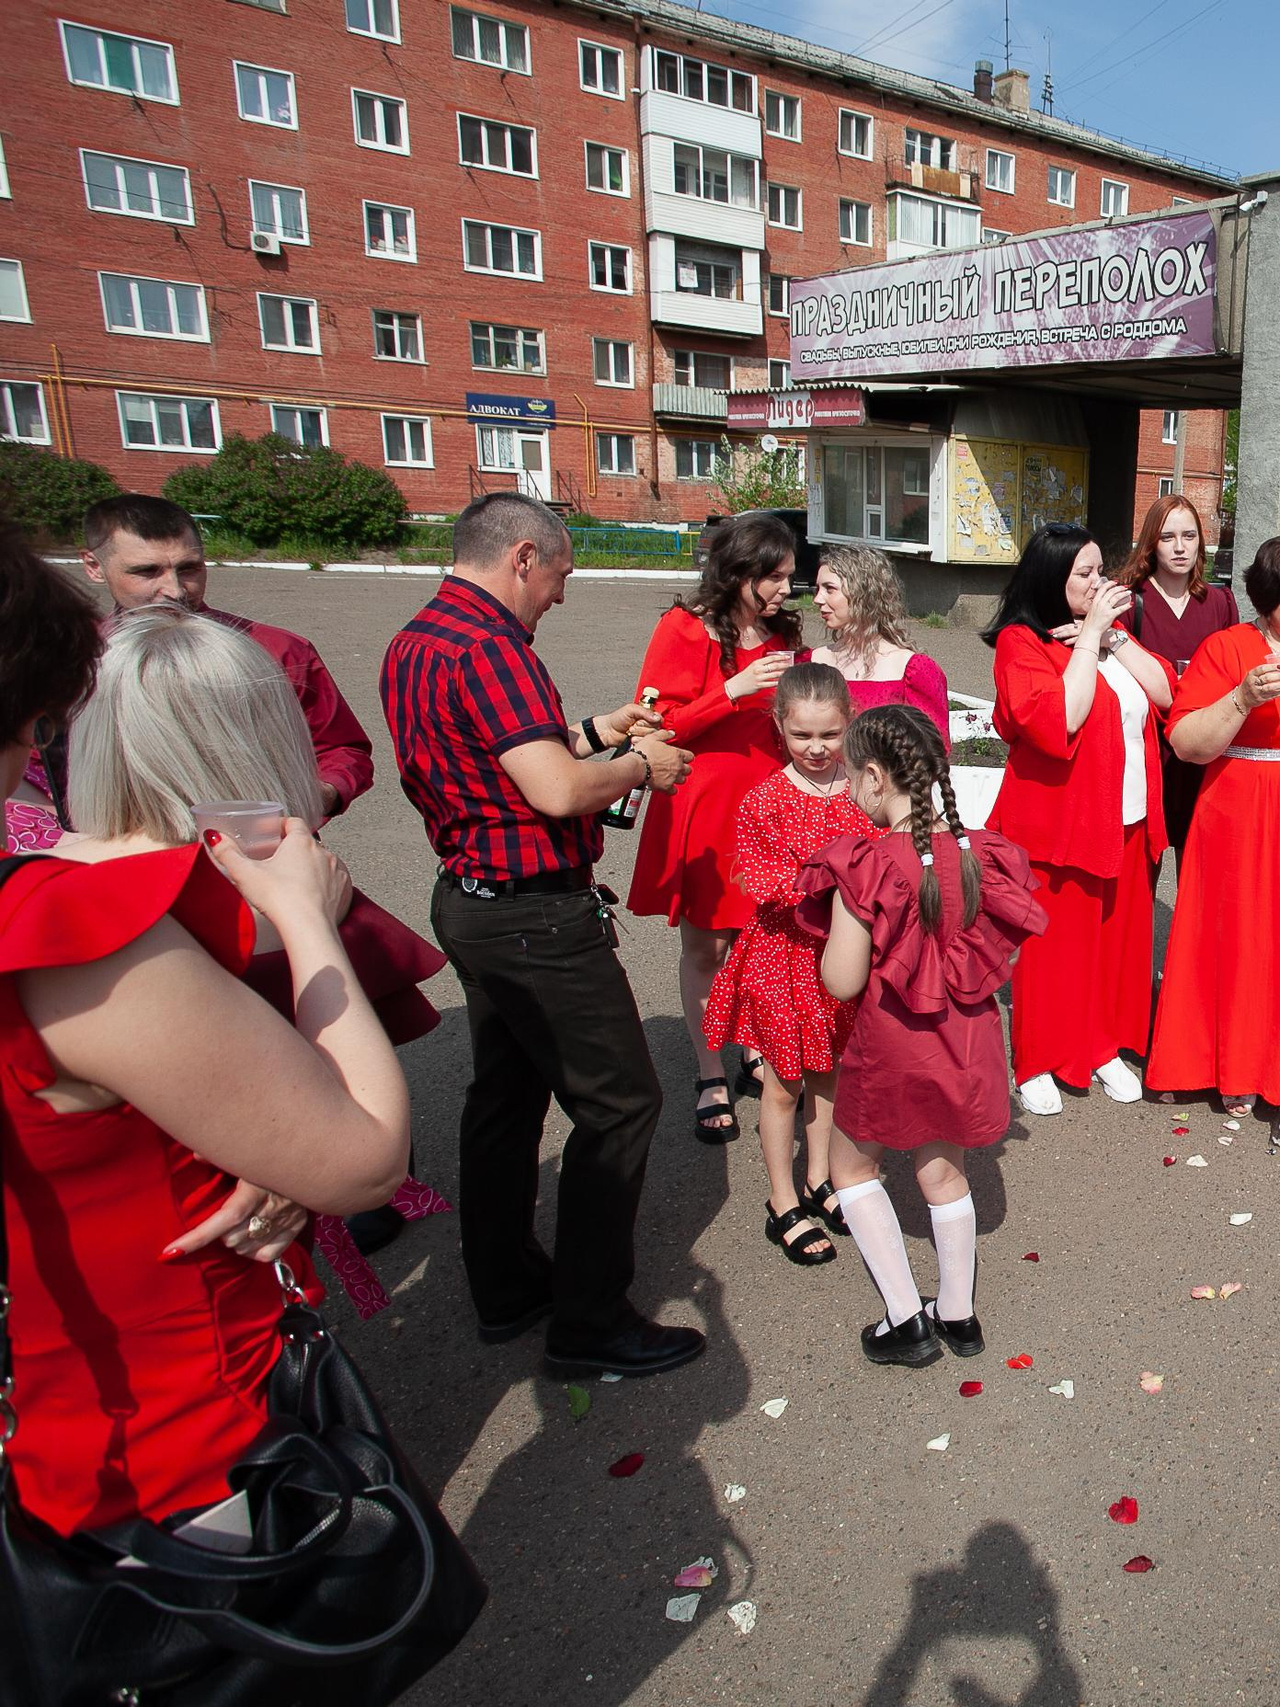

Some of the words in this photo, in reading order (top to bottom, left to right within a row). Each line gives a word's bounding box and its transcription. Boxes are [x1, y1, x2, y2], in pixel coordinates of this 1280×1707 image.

[791, 264, 981, 337] ПРАЗДНИЧНЫЙ
[994, 242, 1208, 314] ПЕРЕПОЛОХ
[946, 336, 970, 349] ДНИ
[971, 328, 1040, 349] РОЖДЕНИЯ,
[1041, 325, 1098, 343] ВСТРЕЧА
[1100, 324, 1112, 339] С
[1114, 317, 1188, 340] РОДДОМА
[469, 404, 521, 416] АДВОКАТ
